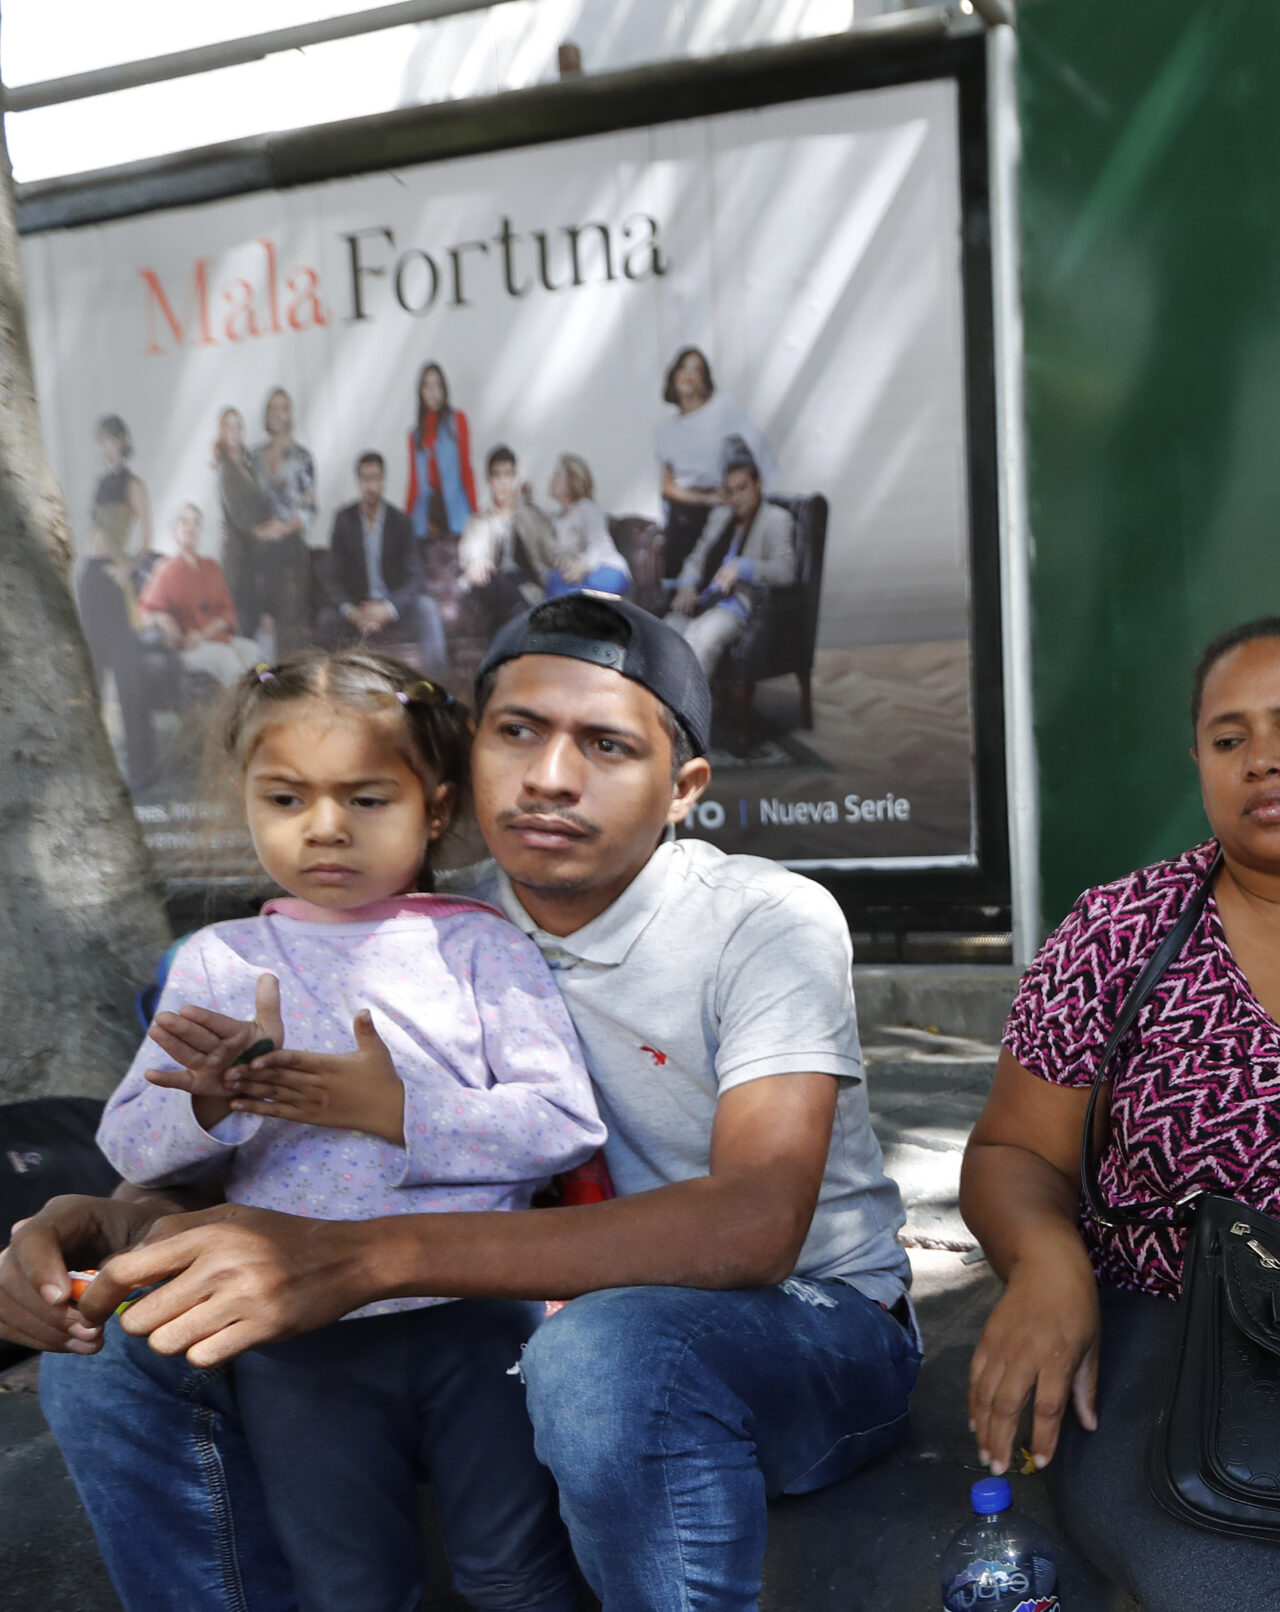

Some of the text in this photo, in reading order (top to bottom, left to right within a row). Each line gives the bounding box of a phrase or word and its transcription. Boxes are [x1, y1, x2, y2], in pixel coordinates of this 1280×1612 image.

[137, 214, 670, 354] Mala Fortuna
[760, 798, 838, 824] Nueva
[845, 793, 910, 823] Serie
